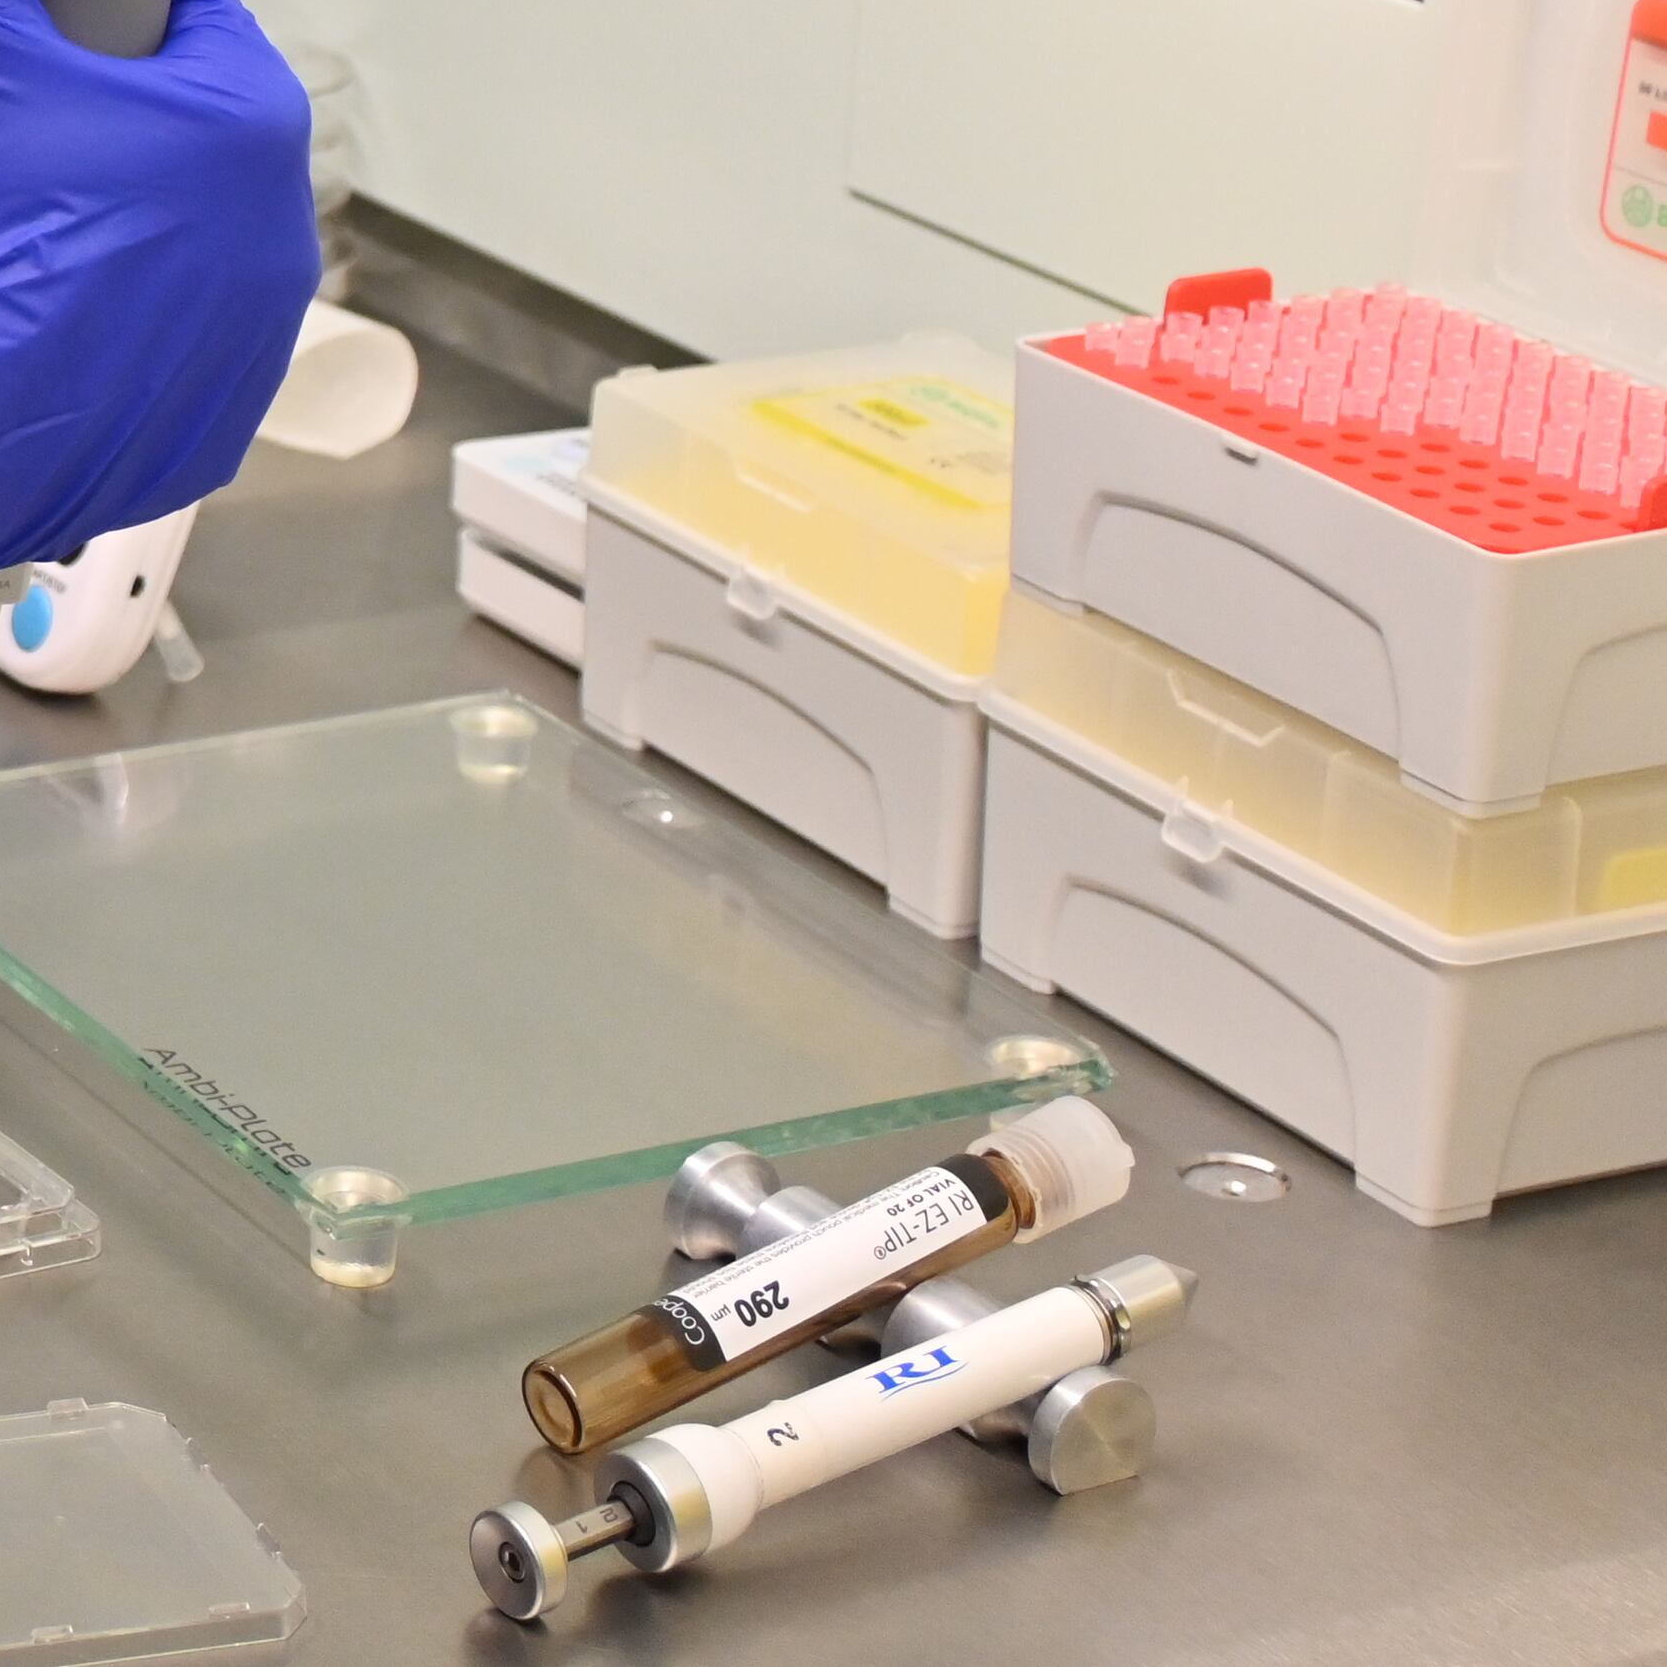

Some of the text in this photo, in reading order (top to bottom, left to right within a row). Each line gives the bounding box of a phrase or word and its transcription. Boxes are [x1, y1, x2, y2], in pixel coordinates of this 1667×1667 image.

[143, 1047, 313, 1169] Ambi-Plate
[886, 1178, 957, 1217] VIAL OF 20
[948, 1189, 975, 1215] RI
[733, 1279, 790, 1328] 290
[865, 1345, 960, 1394] RI
[766, 1421, 800, 1447] 2
[598, 1507, 619, 1524] 2
